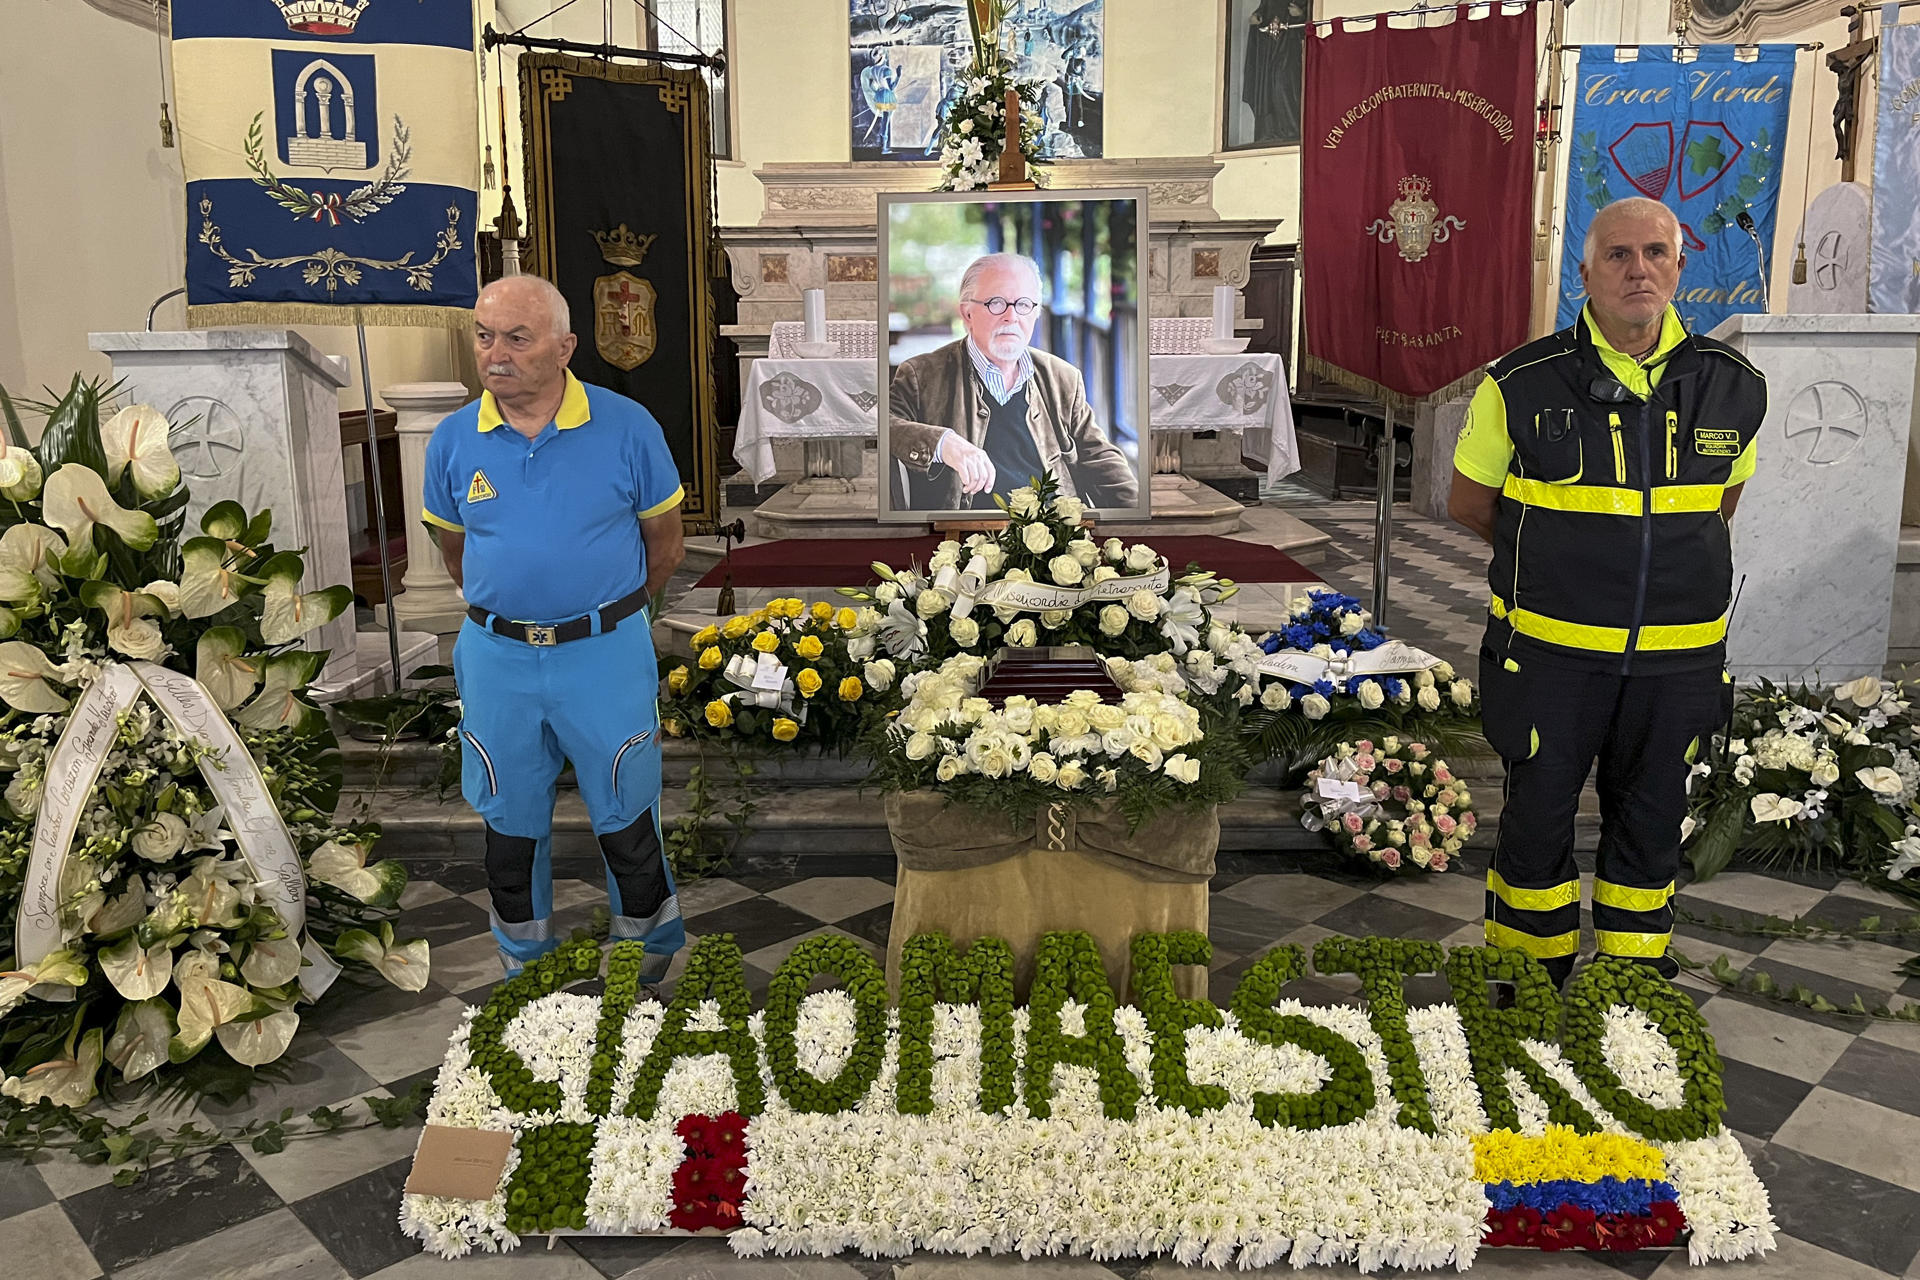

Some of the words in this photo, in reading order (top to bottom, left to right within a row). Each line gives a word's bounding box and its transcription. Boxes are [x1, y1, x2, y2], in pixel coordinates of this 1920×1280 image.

[1584, 74, 1672, 106] Croce
[1688, 70, 1784, 104] Verde
[1323, 126, 1344, 150] VEN
[1454, 89, 1514, 146] MISERICORDIA
[1700, 432, 1724, 440] MARCO
[468, 931, 893, 1121] CIAO
[899, 929, 1725, 1142] MAESTRO
